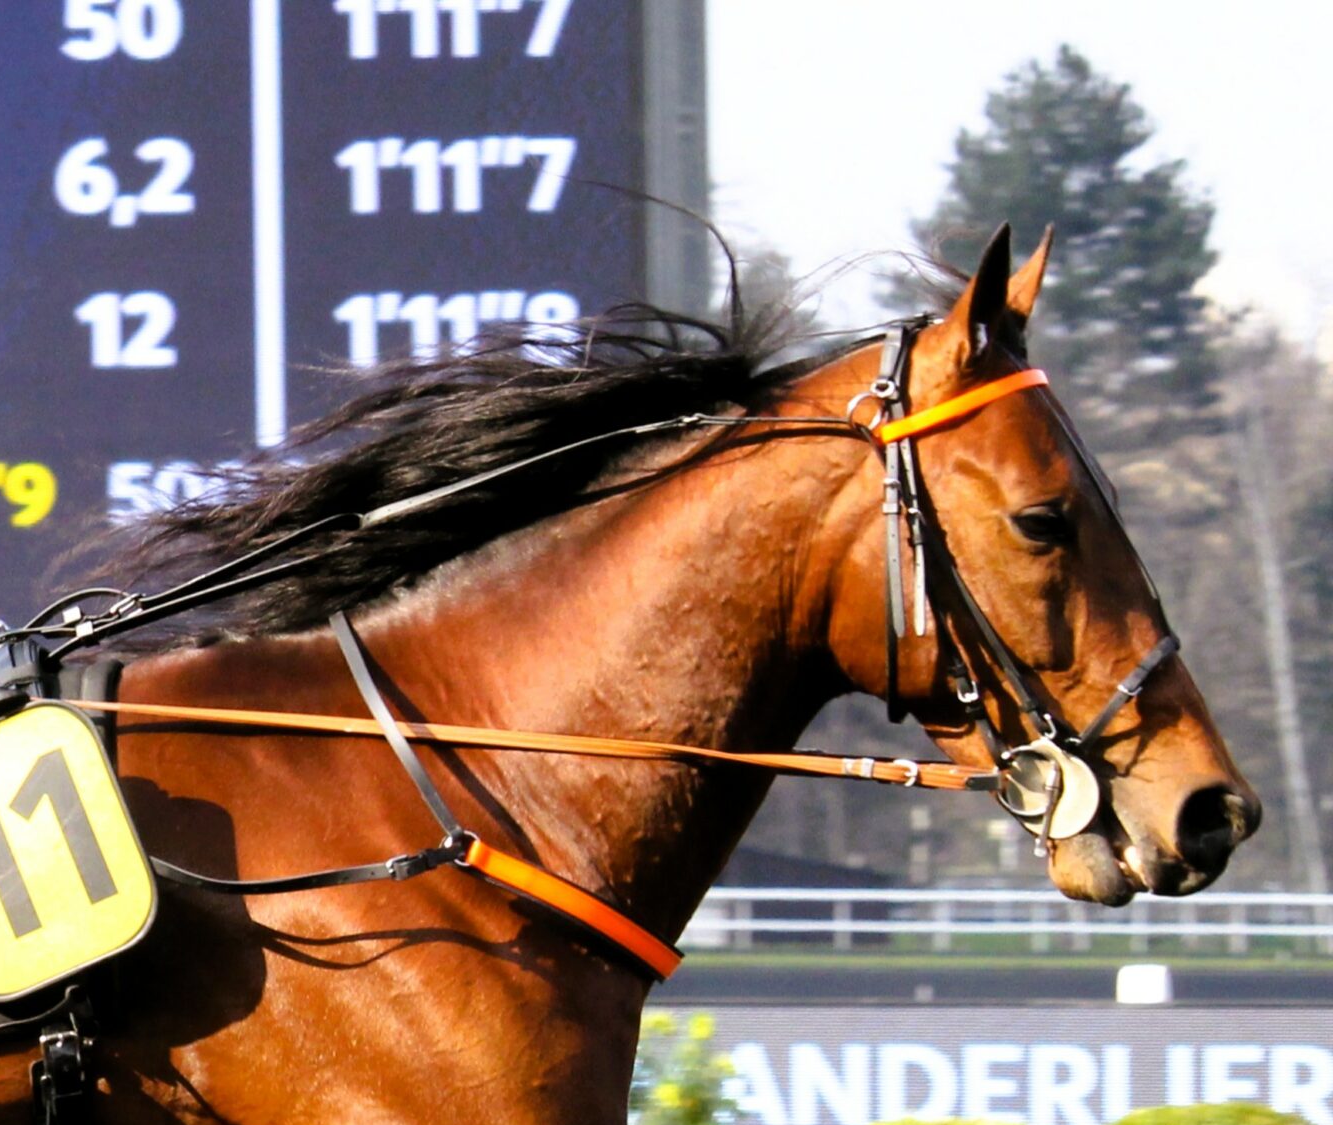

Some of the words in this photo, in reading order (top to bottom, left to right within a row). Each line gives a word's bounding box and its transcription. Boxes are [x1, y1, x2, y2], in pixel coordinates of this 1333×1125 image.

[60, 0, 183, 61] 50
[54, 138, 195, 227] 6,2
[74, 292, 178, 368] 12
